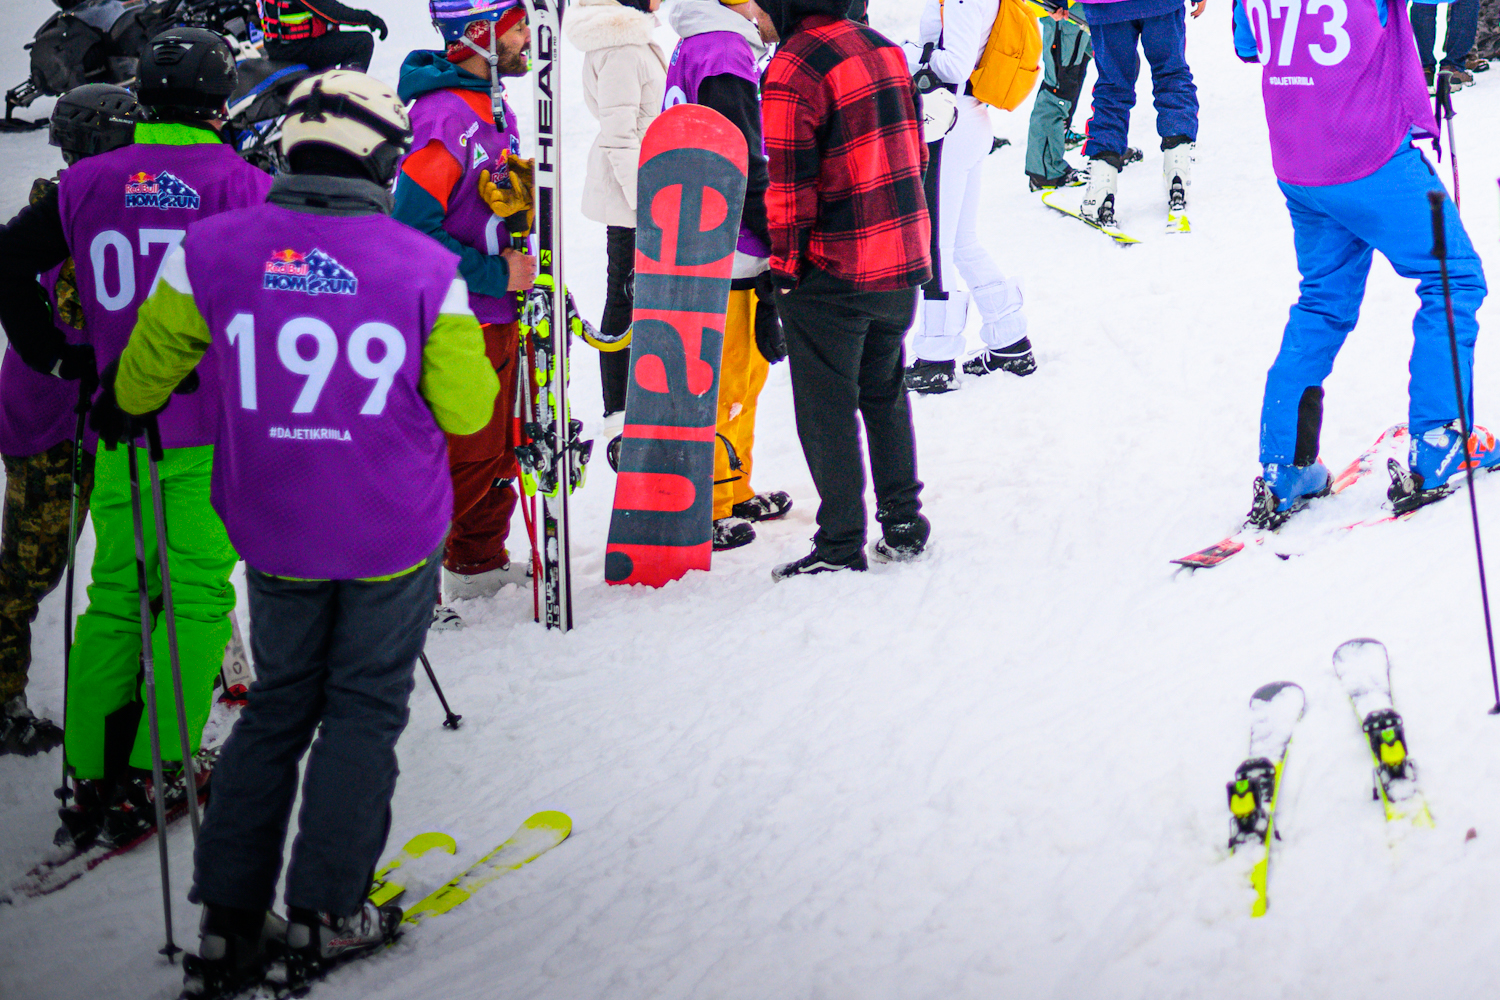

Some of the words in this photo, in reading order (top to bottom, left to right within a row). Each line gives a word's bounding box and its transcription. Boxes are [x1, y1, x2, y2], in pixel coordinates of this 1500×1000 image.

[537, 24, 554, 173] HEAD
[125, 184, 140, 194] Red
[142, 184, 159, 194] Bull
[265, 262, 286, 274] Red
[288, 264, 309, 276] Bull
[225, 313, 407, 415] 199
